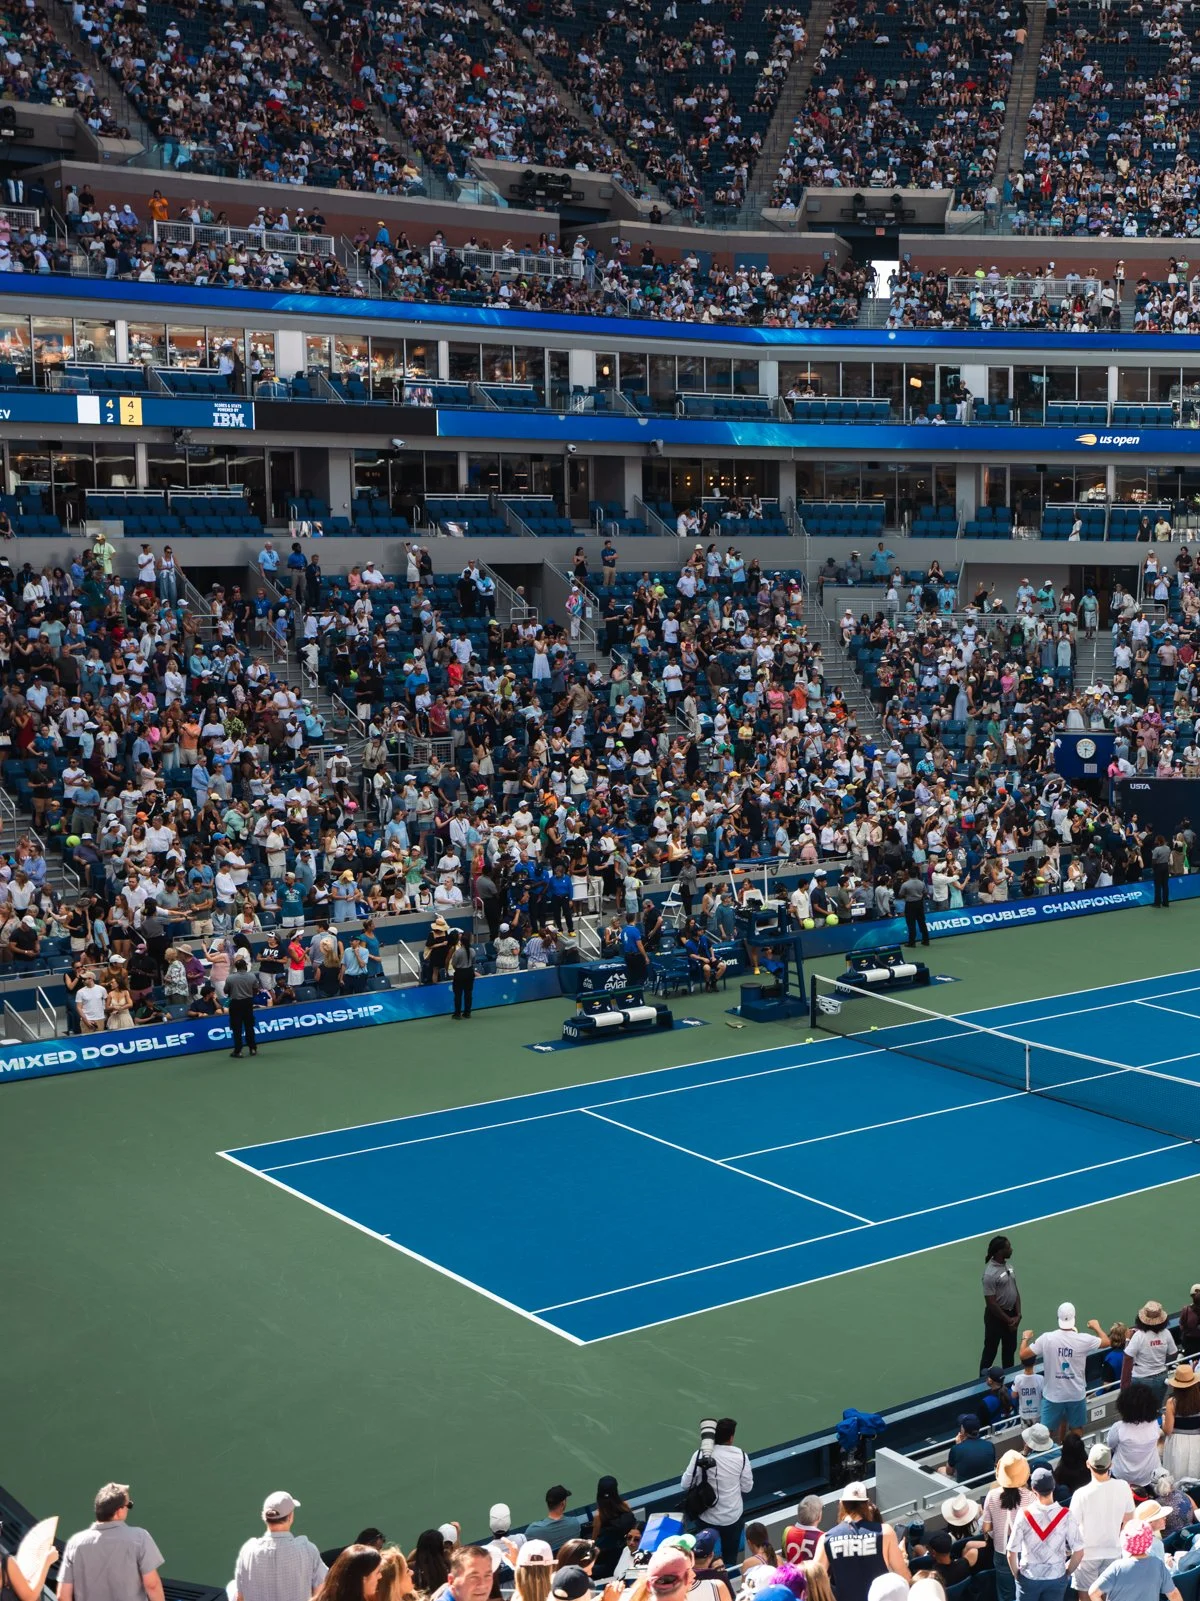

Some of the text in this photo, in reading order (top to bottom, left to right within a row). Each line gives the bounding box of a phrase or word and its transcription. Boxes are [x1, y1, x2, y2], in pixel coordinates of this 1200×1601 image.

[106, 400, 135, 409] 4 4
[106, 413, 135, 423] 2 2
[212, 412, 245, 428] IBM
[1112, 436, 1140, 446] open
[1042, 891, 1142, 914] CHAMPIONSHIP
[926, 907, 1036, 932] MIXED DOUBLES
[262, 948, 279, 956] NYC
[563, 1024, 578, 1037] POLO
[0, 1050, 77, 1072] MIXED
